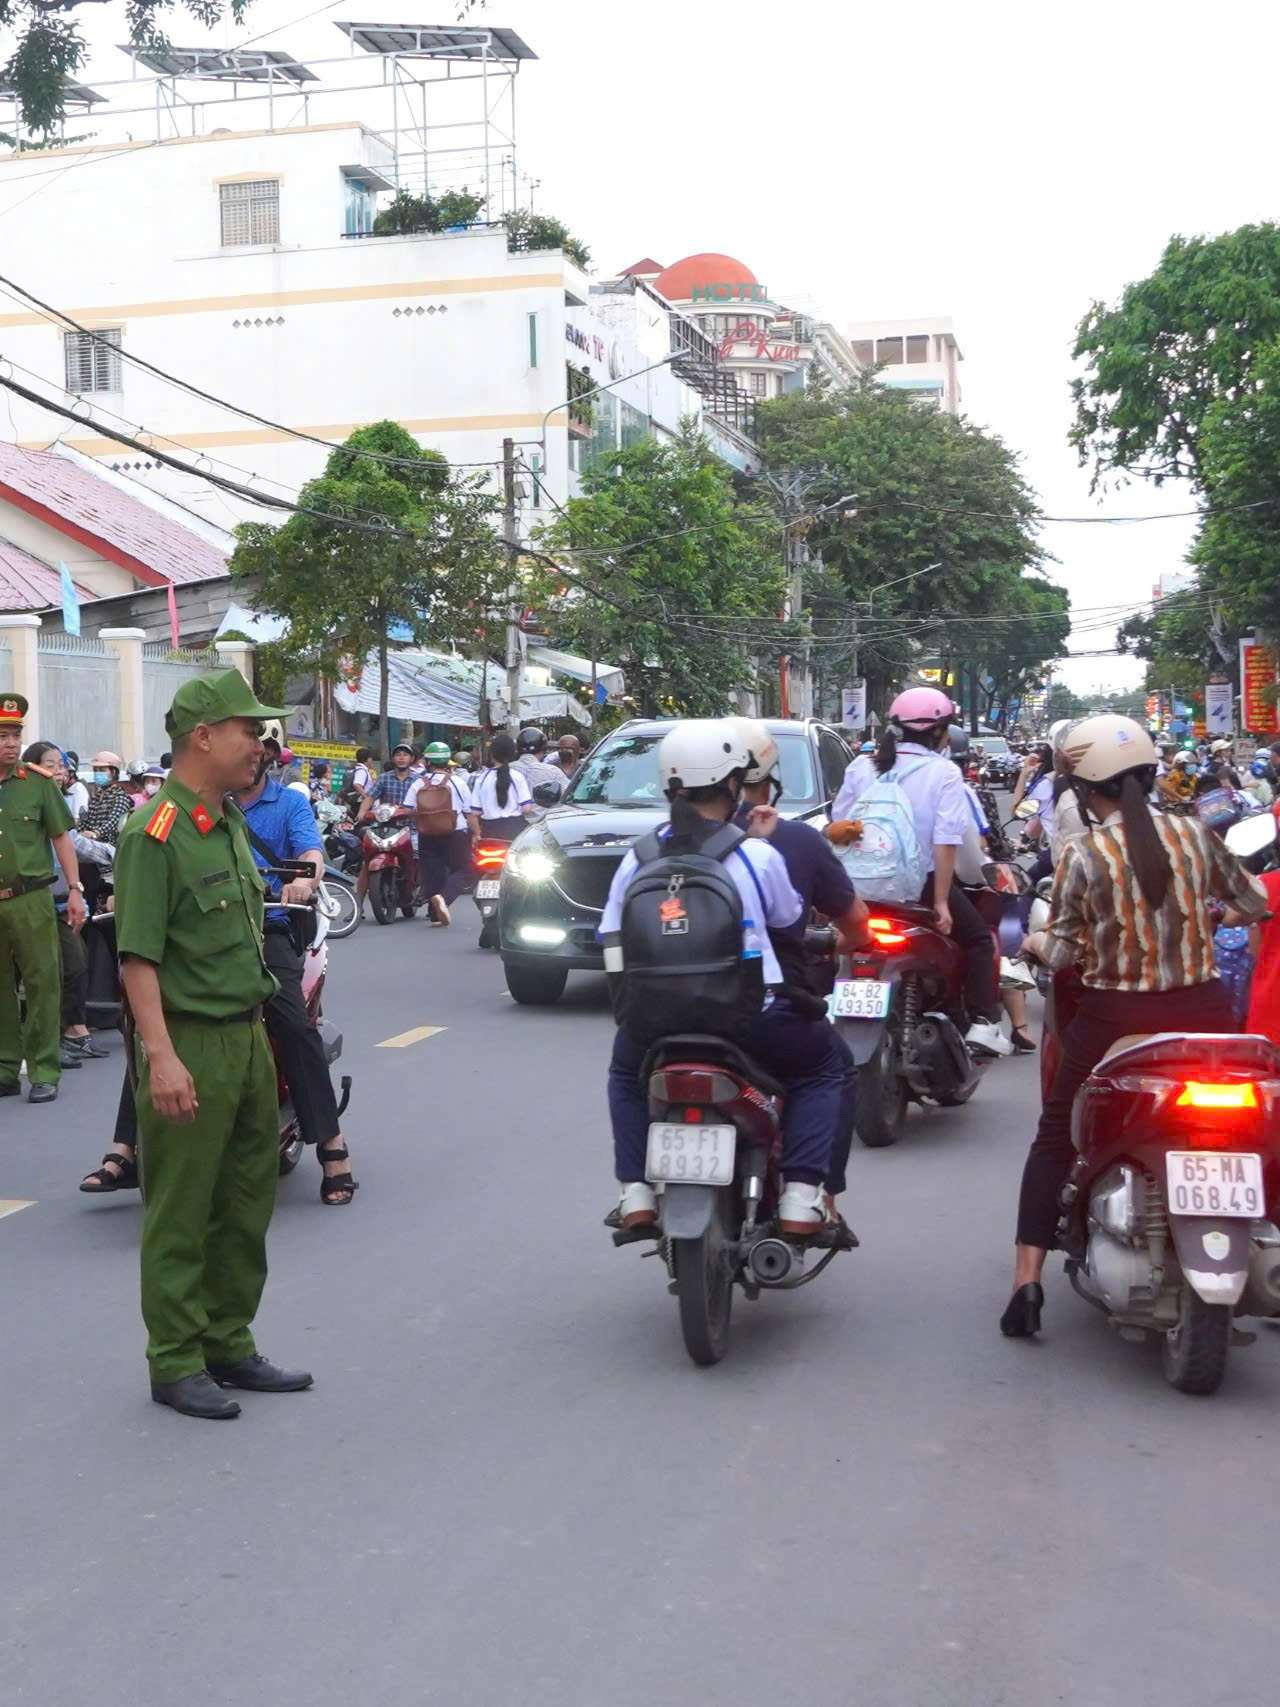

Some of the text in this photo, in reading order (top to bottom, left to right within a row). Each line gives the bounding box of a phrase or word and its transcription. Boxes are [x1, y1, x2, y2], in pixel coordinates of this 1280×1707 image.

[692, 283, 774, 304] HOTEL
[1183, 1157, 1246, 1183] 65-MA
[1175, 1185, 1258, 1212] 068.49
